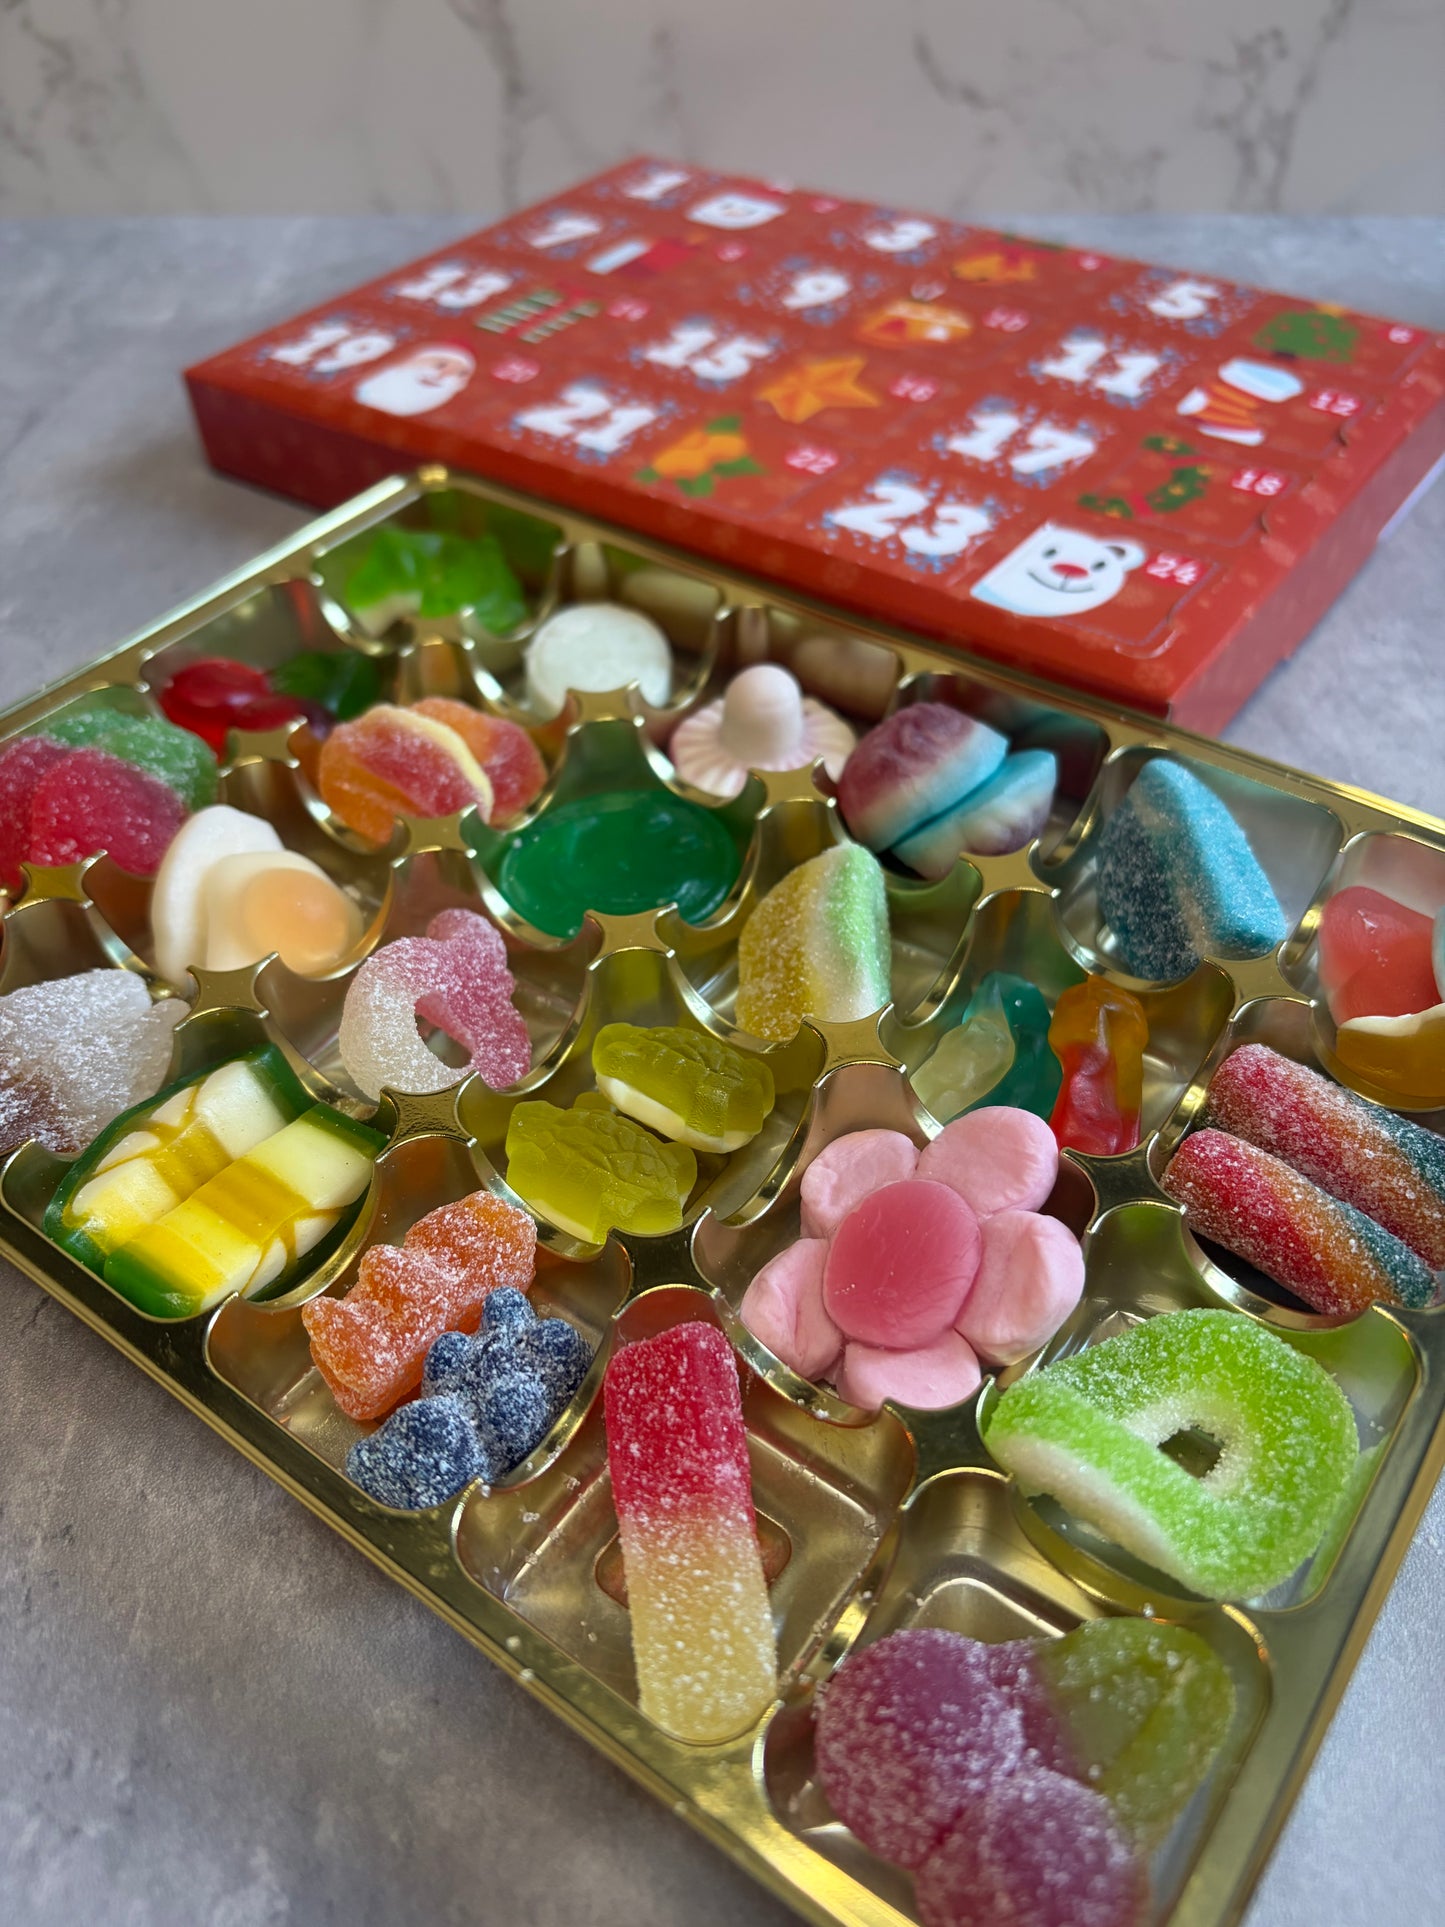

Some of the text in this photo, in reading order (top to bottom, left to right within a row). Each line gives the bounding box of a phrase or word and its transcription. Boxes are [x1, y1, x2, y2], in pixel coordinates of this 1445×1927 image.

[864, 220, 936, 252] 3
[397, 262, 512, 308] 13
[781, 269, 851, 308] 9
[1148, 281, 1222, 319] 5
[269, 325, 396, 373] 19
[644, 325, 773, 382] 15
[1040, 336, 1161, 399] 11
[517, 384, 655, 453] 21
[949, 412, 1096, 474] 17
[1232, 470, 1285, 496] 18
[832, 483, 990, 556] 23
[1147, 553, 1199, 585] 24
